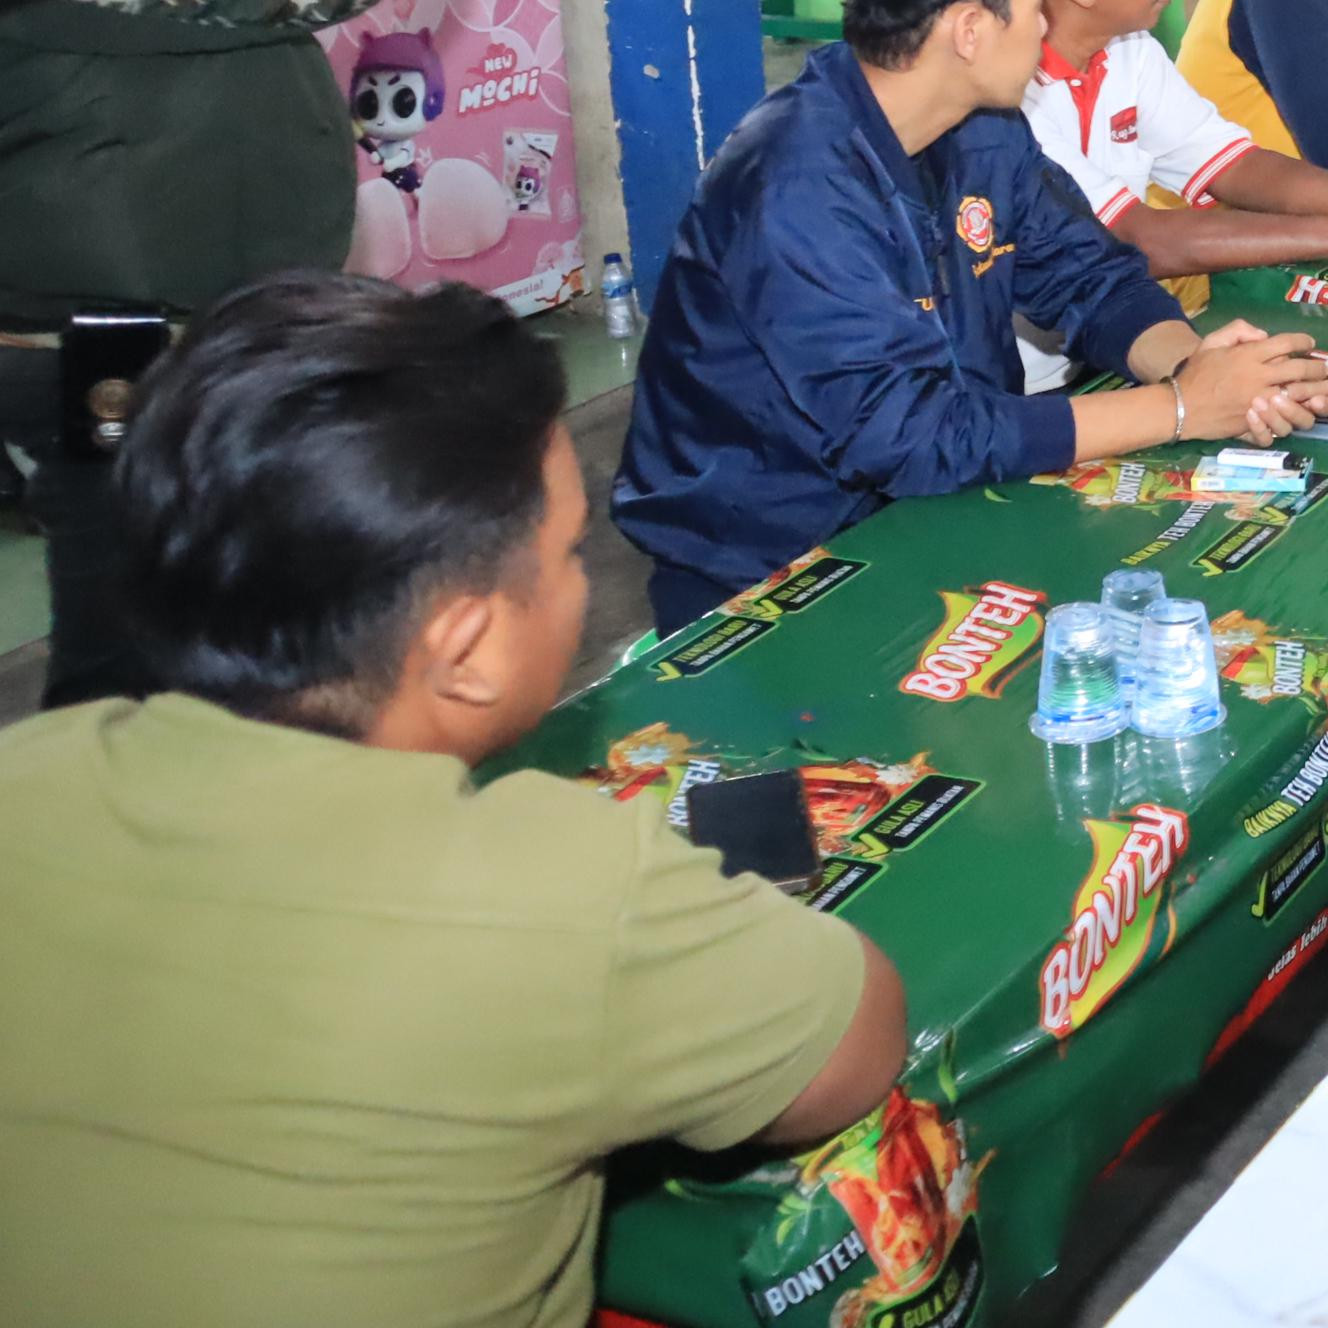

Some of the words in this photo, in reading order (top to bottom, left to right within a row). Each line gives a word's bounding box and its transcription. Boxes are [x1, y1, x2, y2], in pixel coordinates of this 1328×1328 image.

[484, 53, 513, 73] NEW
[1112, 462, 1145, 504] BONTEH
[903, 581, 1042, 700] BONTEH
[1273, 640, 1306, 696] BONTEH
[1243, 799, 1298, 839] BAIKNYA
[1280, 775, 1317, 807] TEH
[1042, 803, 1185, 1032] BONTEH
[764, 1229, 867, 1318] BONTEH
